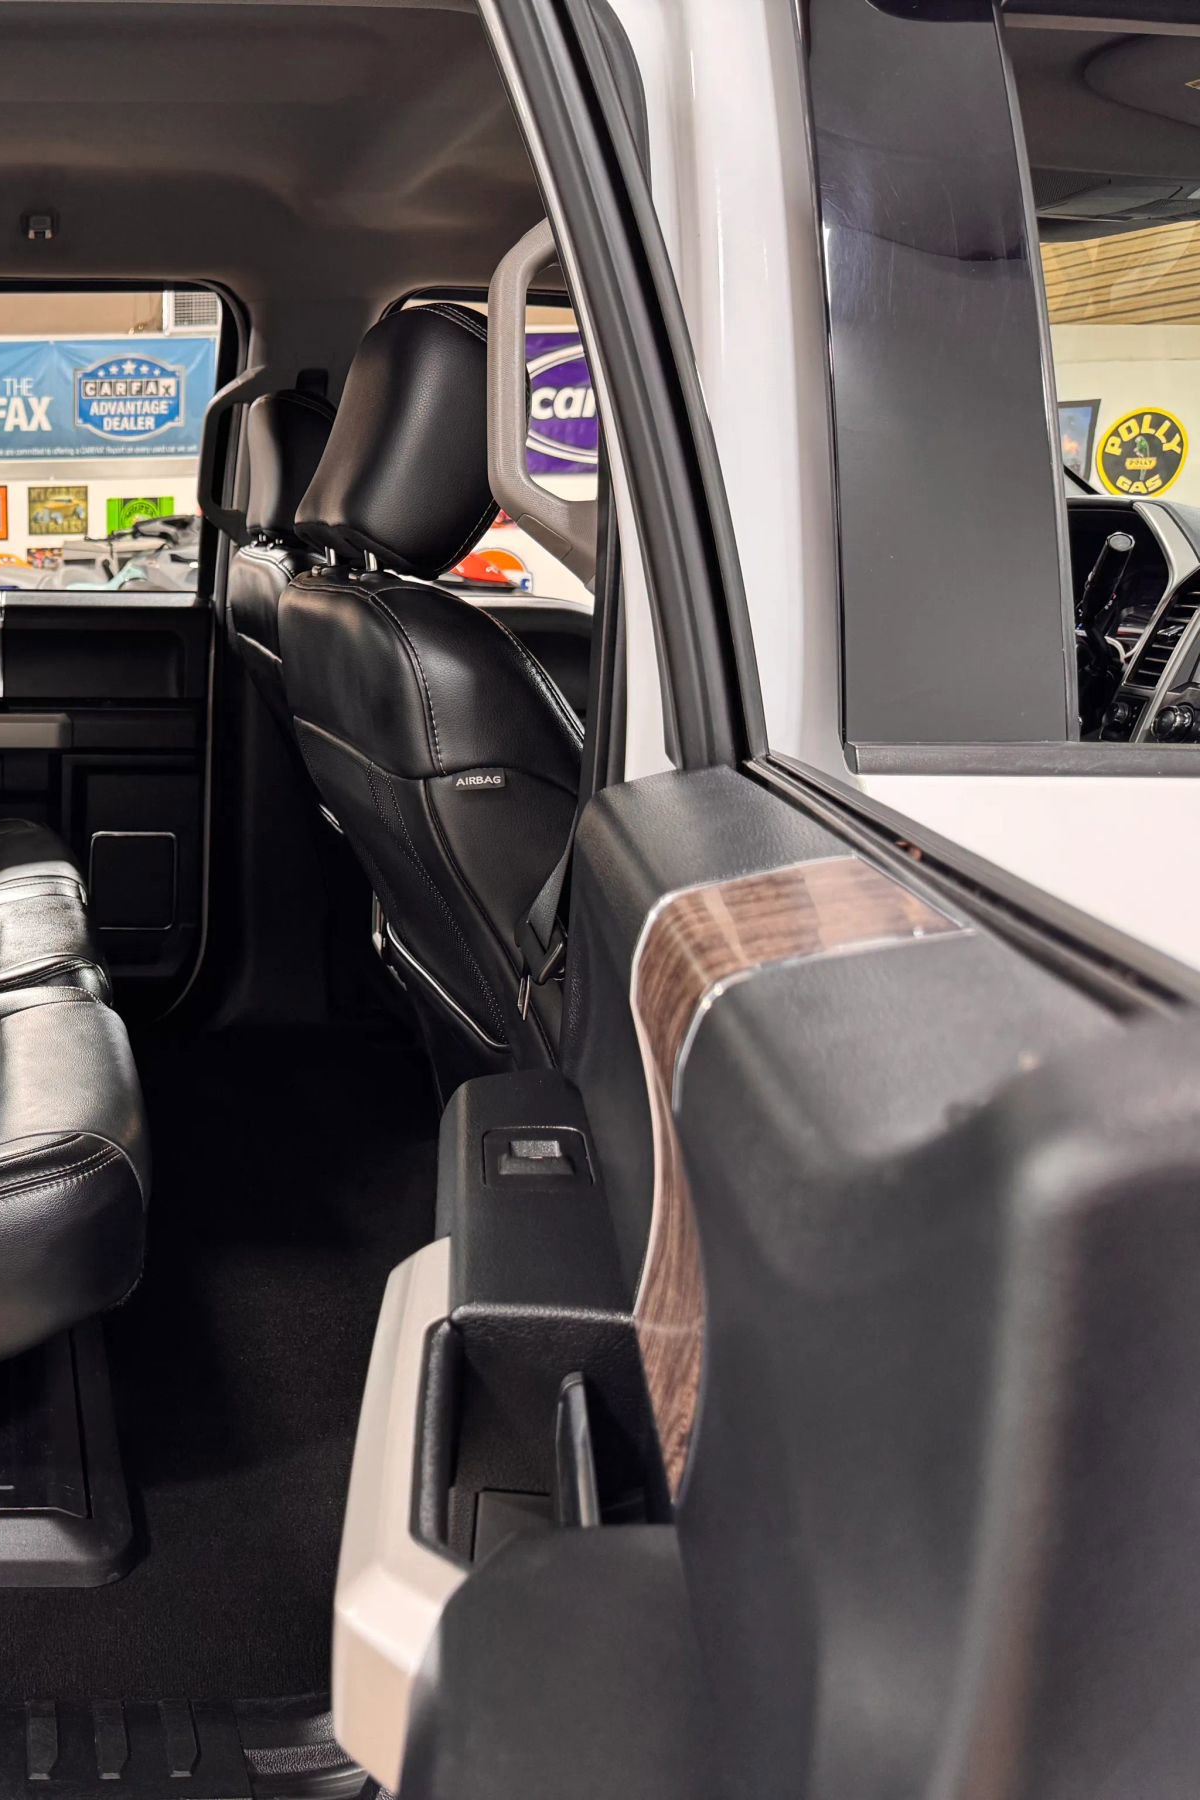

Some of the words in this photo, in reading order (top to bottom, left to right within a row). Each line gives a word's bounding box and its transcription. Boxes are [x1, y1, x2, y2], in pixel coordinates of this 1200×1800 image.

[3, 377, 33, 396] THE
[83, 380, 173, 397] CARFAX
[89, 400, 170, 416] ADVANTAGE
[103, 416, 155, 431] DEALER
[1104, 414, 1182, 456] POLLY
[1116, 474, 1162, 493] GAS
[456, 776, 501, 787] AIRBAG
